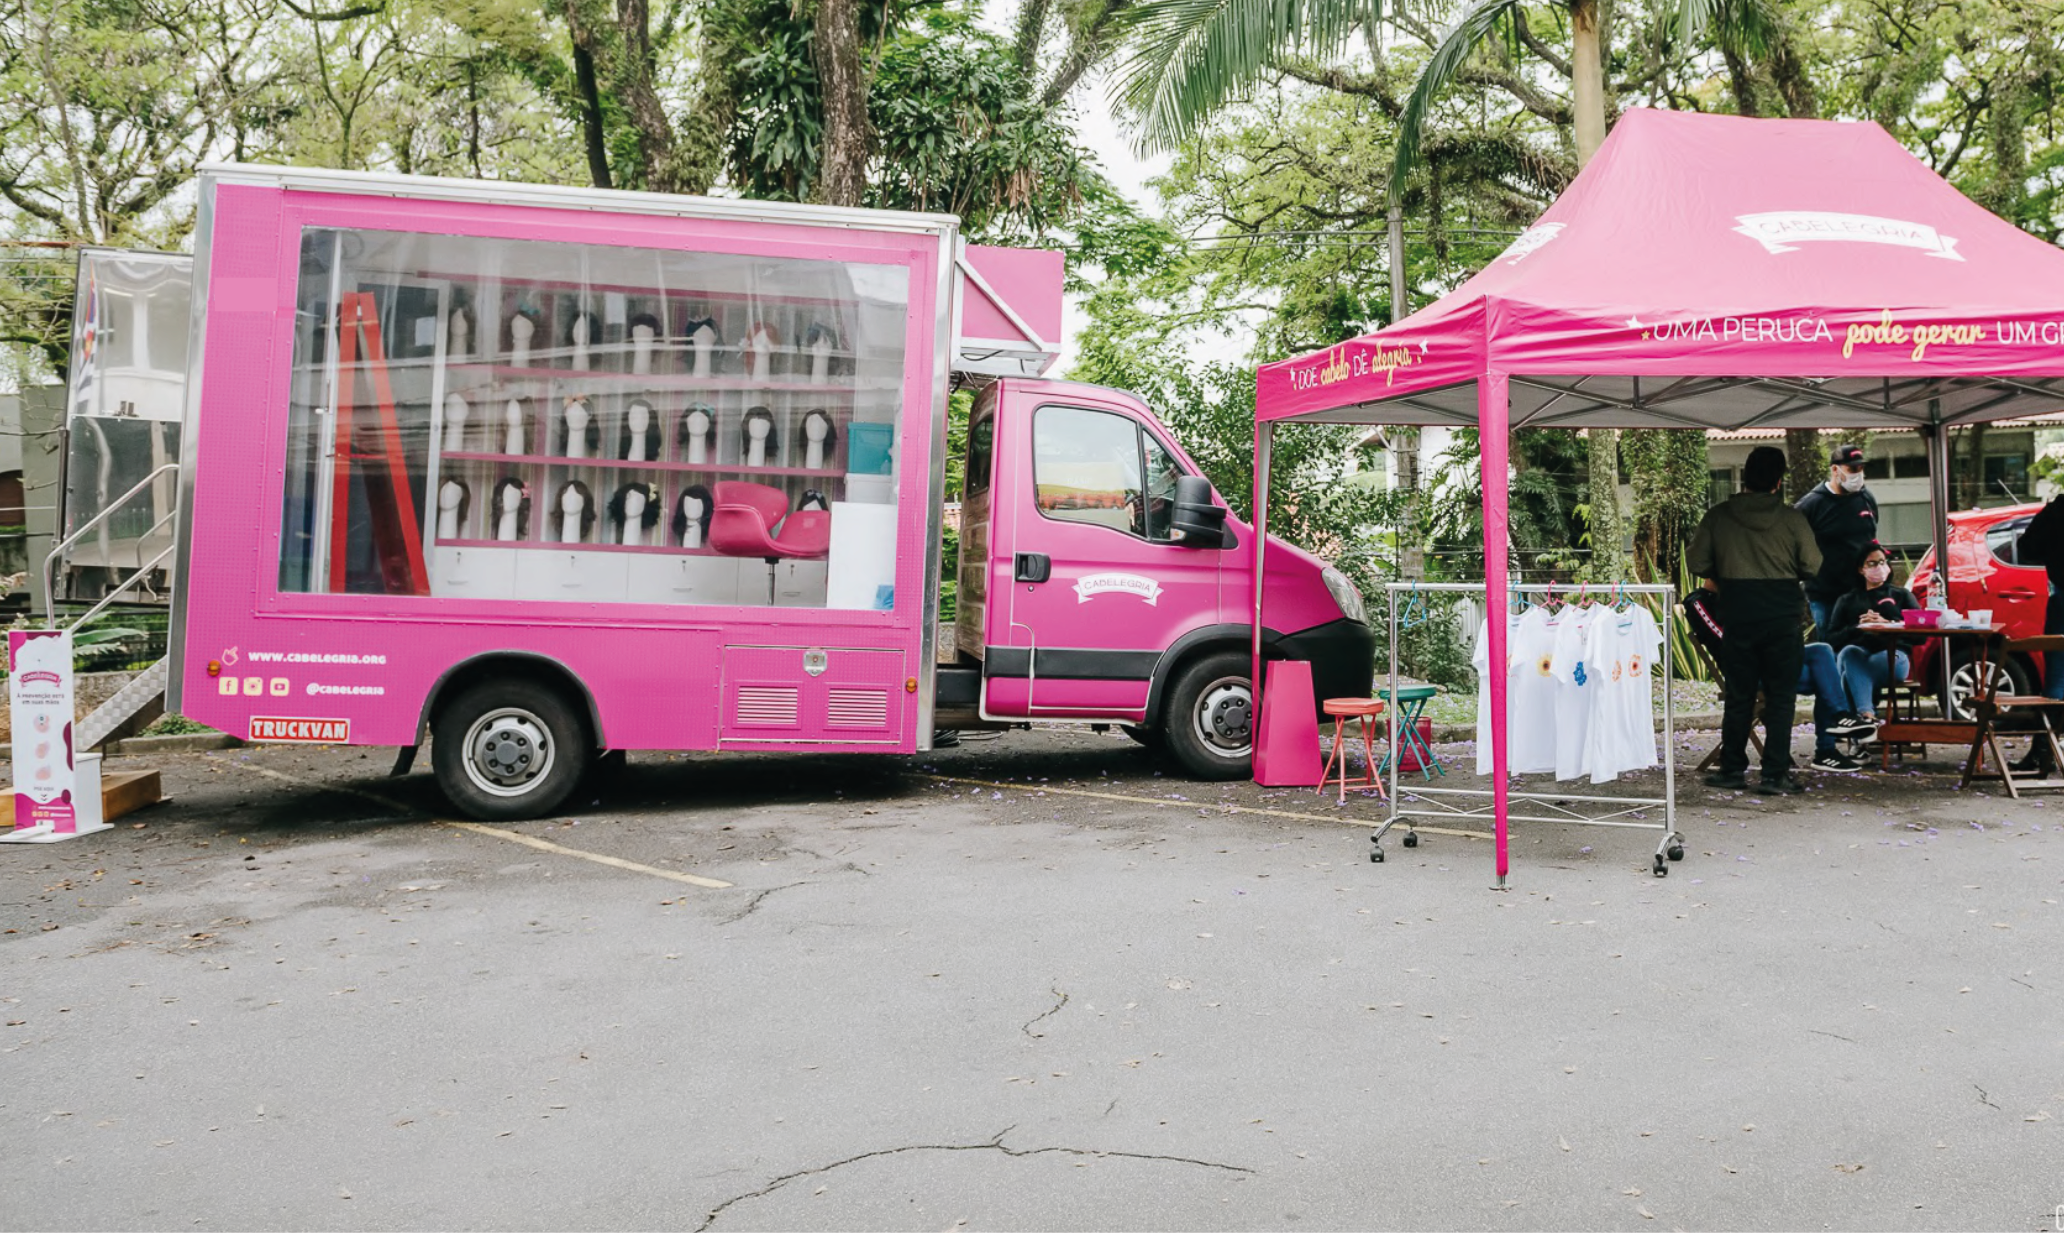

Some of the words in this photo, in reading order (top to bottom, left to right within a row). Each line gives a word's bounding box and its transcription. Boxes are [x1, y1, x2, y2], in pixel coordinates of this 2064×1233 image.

[1759, 221, 1924, 239] CABELEGRIA
[1653, 318, 1718, 342] UMA
[1723, 317, 1834, 342] PERUCA
[1842, 308, 1909, 359] pode
[1911, 324, 1986, 362] gerar
[1997, 321, 2036, 344] UM
[1299, 367, 1318, 389] DOE
[1320, 346, 1350, 385] cabelo
[1353, 348, 1368, 377] DÊ
[1372, 339, 1412, 387] alegria
[1084, 578, 1150, 592] CABELEGRIA
[253, 721, 346, 739] TRUCKVAN
